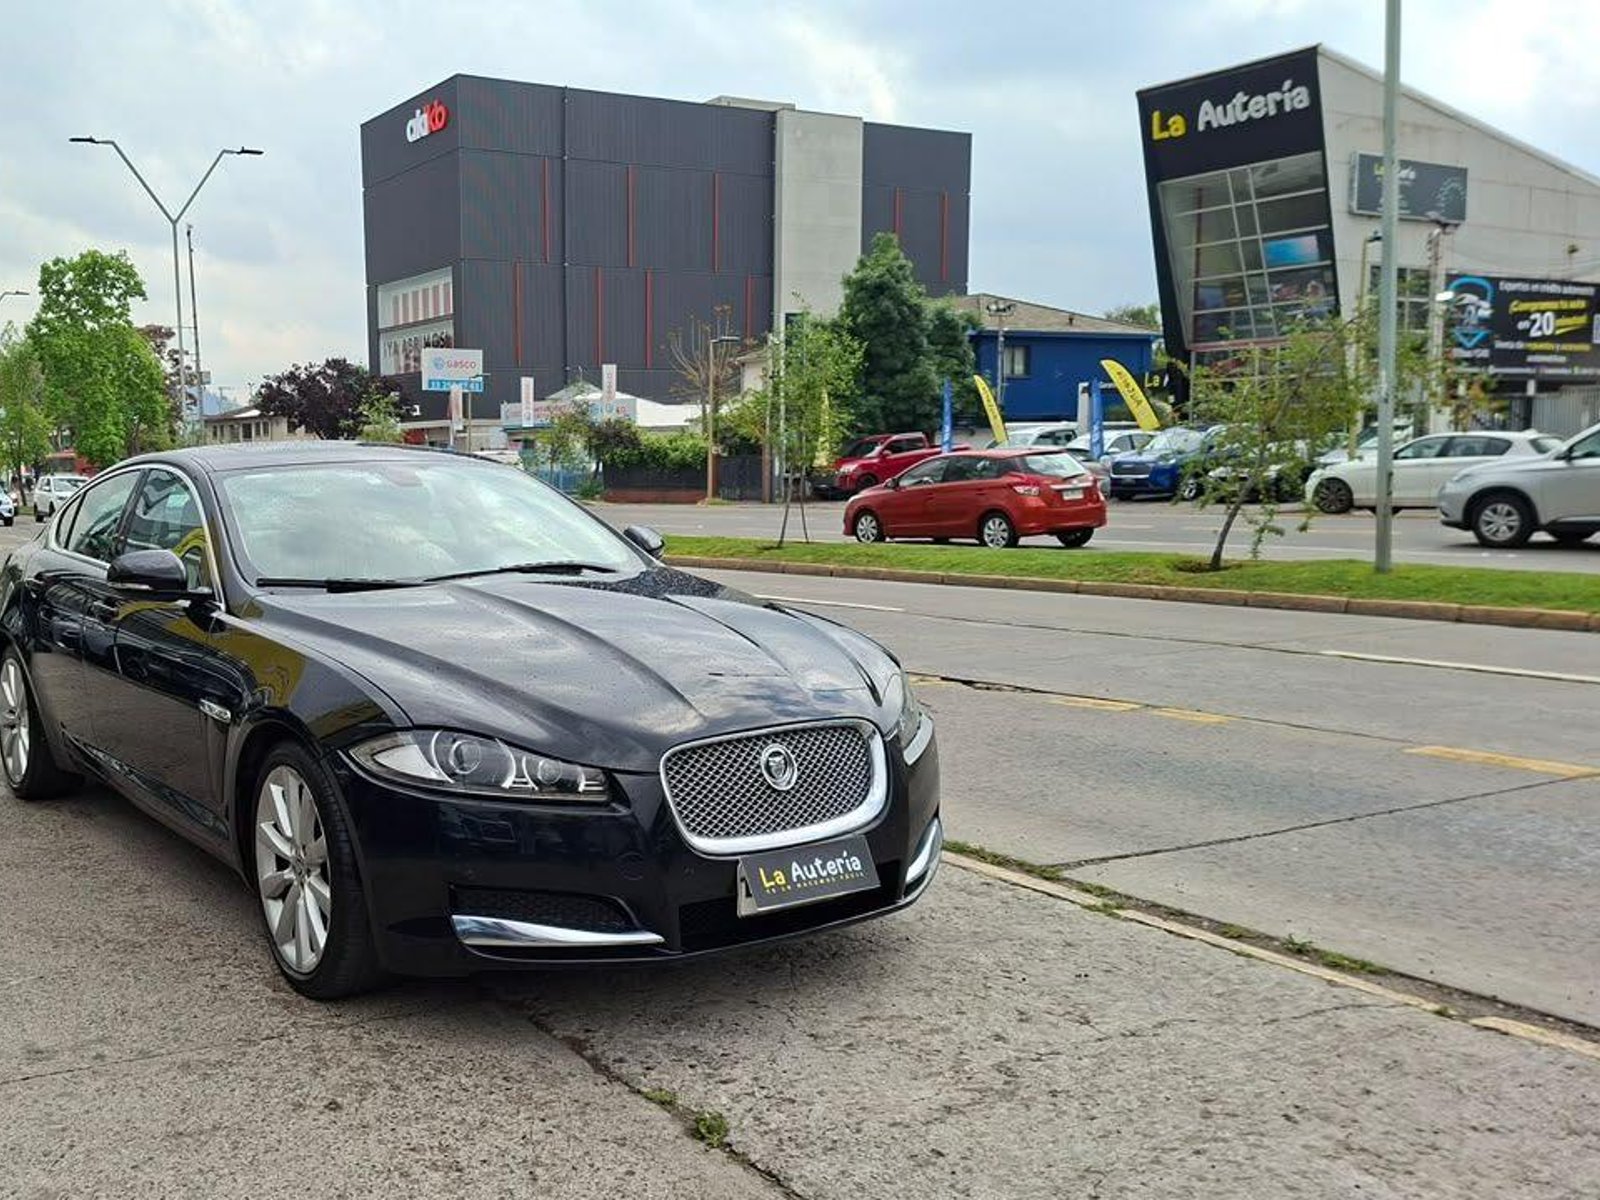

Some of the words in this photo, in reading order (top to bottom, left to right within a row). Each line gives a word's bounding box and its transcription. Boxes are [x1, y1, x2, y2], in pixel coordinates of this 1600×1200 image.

[1152, 110, 1186, 140] La
[1197, 79, 1311, 132] Autería
[1529, 311, 1555, 337] 20
[1145, 371, 1160, 387] La
[758, 867, 786, 888] La
[791, 850, 862, 882] Autería
